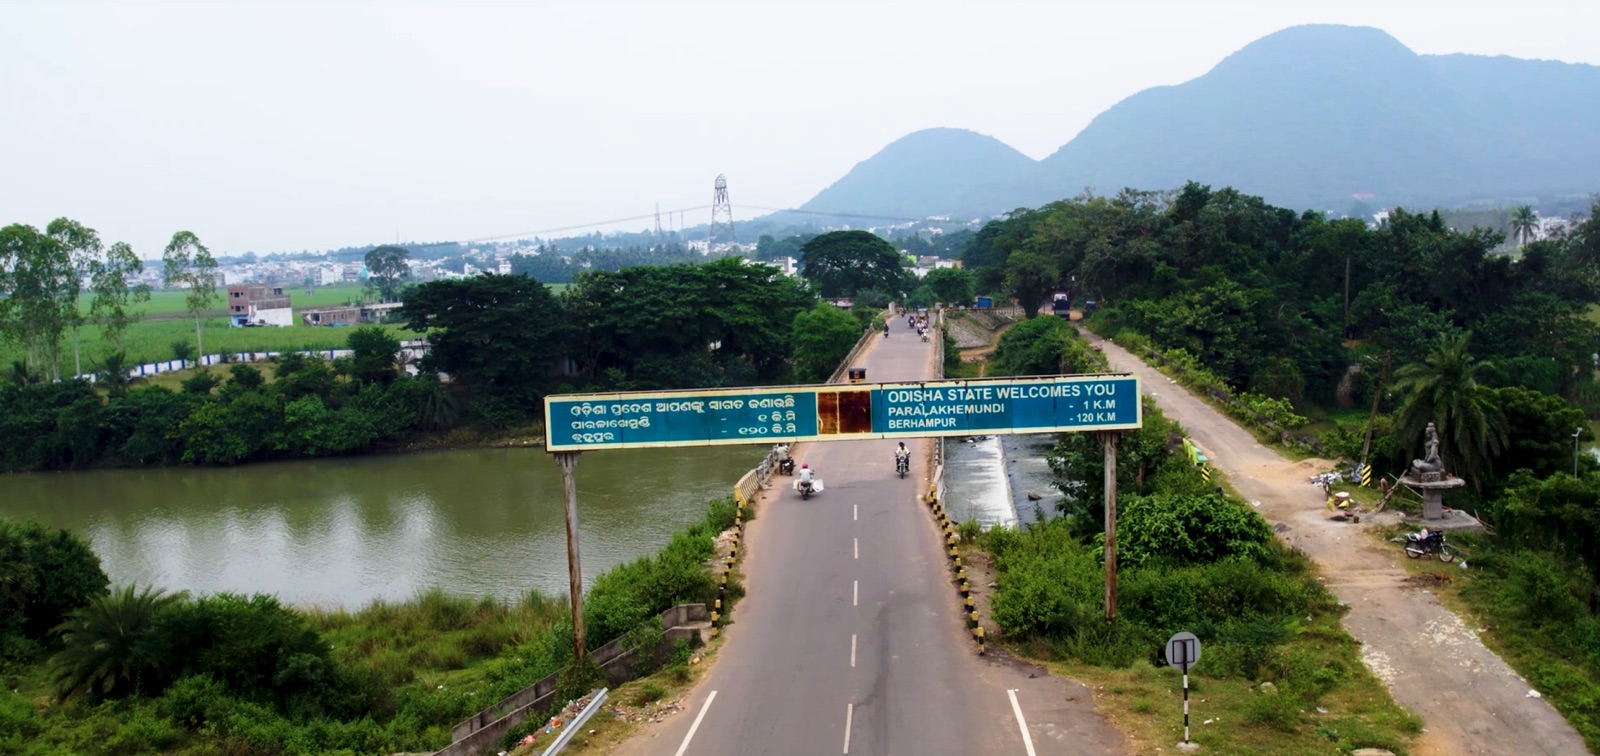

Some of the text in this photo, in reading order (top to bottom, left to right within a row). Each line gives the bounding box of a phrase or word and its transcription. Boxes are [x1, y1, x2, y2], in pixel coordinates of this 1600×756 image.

[888, 383, 1116, 402] ODISHA STATE WELCOMES YOU
[610, 402, 652, 416] ପ୍ରଦେଶ
[888, 404, 1004, 416] PARALAKHEMUNDI
[1083, 401, 1089, 410] 1
[1093, 400, 1116, 410] K.M
[888, 417, 957, 429] BERHAMPUR
[1077, 413, 1093, 423] 120
[1096, 412, 1116, 422] K.M
